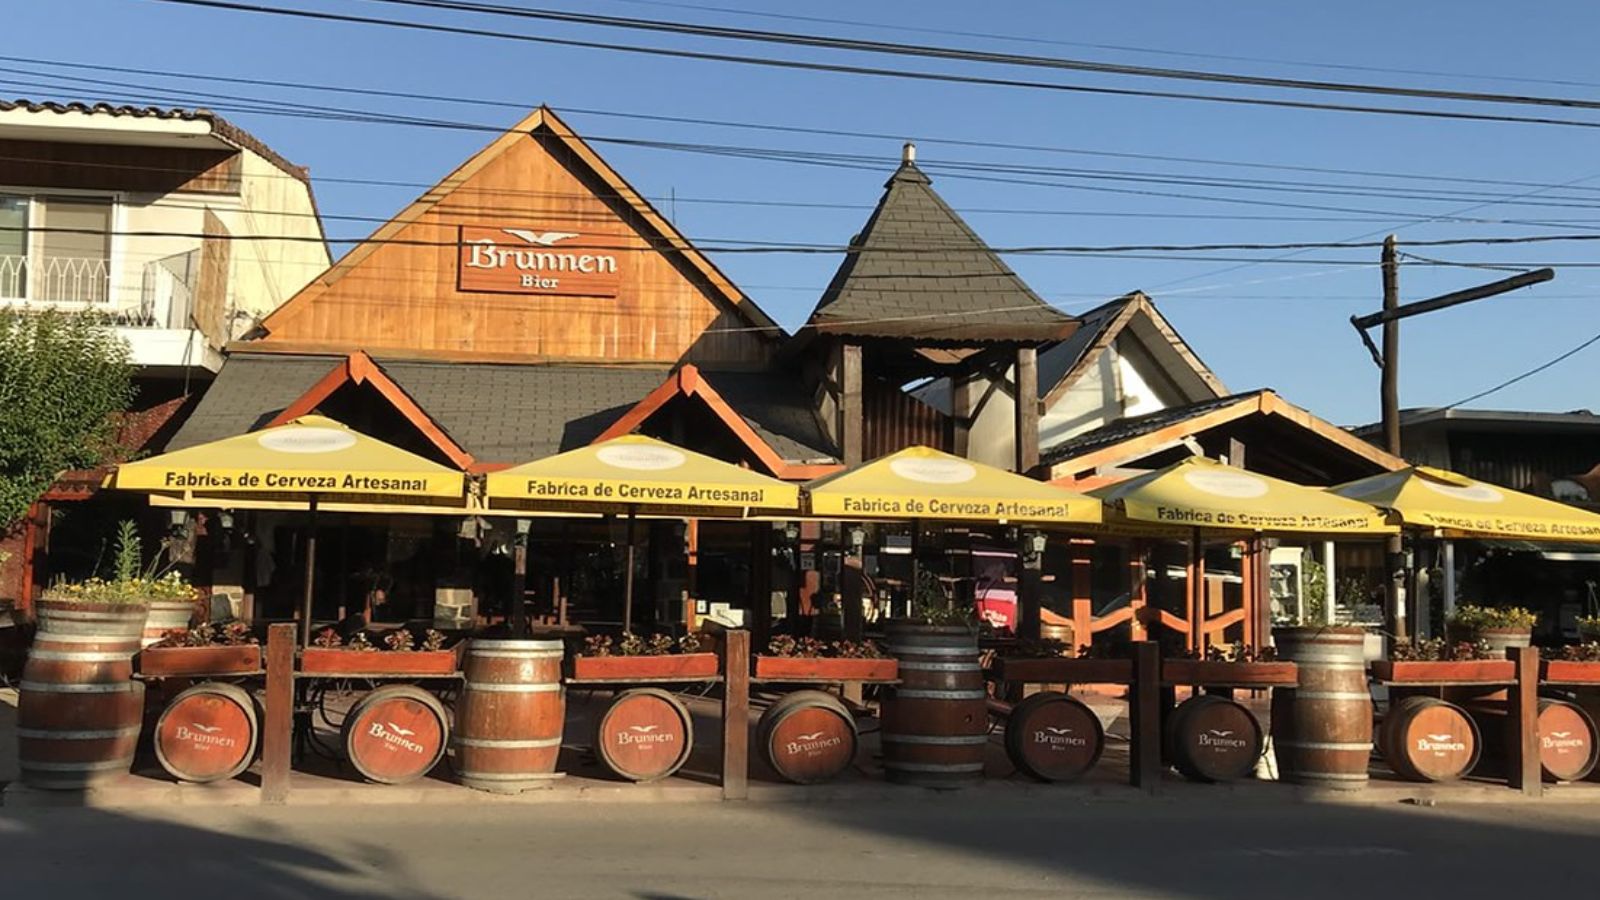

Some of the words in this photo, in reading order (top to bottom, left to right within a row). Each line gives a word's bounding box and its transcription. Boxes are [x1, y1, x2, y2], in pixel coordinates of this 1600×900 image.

[465, 238, 617, 274] Brunnen
[521, 274, 559, 289] Bier
[165, 471, 232, 488] Fabrica
[238, 473, 259, 488] de
[265, 473, 337, 490] Cerveza
[342, 474, 427, 492] Artesanal
[527, 480, 588, 497] Fabrica
[594, 483, 613, 497] de
[619, 483, 683, 500] Cerveza
[687, 485, 764, 502] Artesanal
[844, 497, 900, 513] Fabrica
[906, 498, 924, 513] de
[929, 499, 990, 515] Cerveza
[995, 502, 1069, 518] Artesanal
[1157, 507, 1212, 524] Fabrica
[1217, 512, 1235, 524] de
[175, 725, 235, 748] Brunnen
[368, 722, 424, 754] Brunnen
[617, 732, 674, 745] Brunnen
[785, 736, 841, 755] Brunnen
[1034, 731, 1086, 747] Brunnen
[1198, 734, 1246, 748] Brunnen
